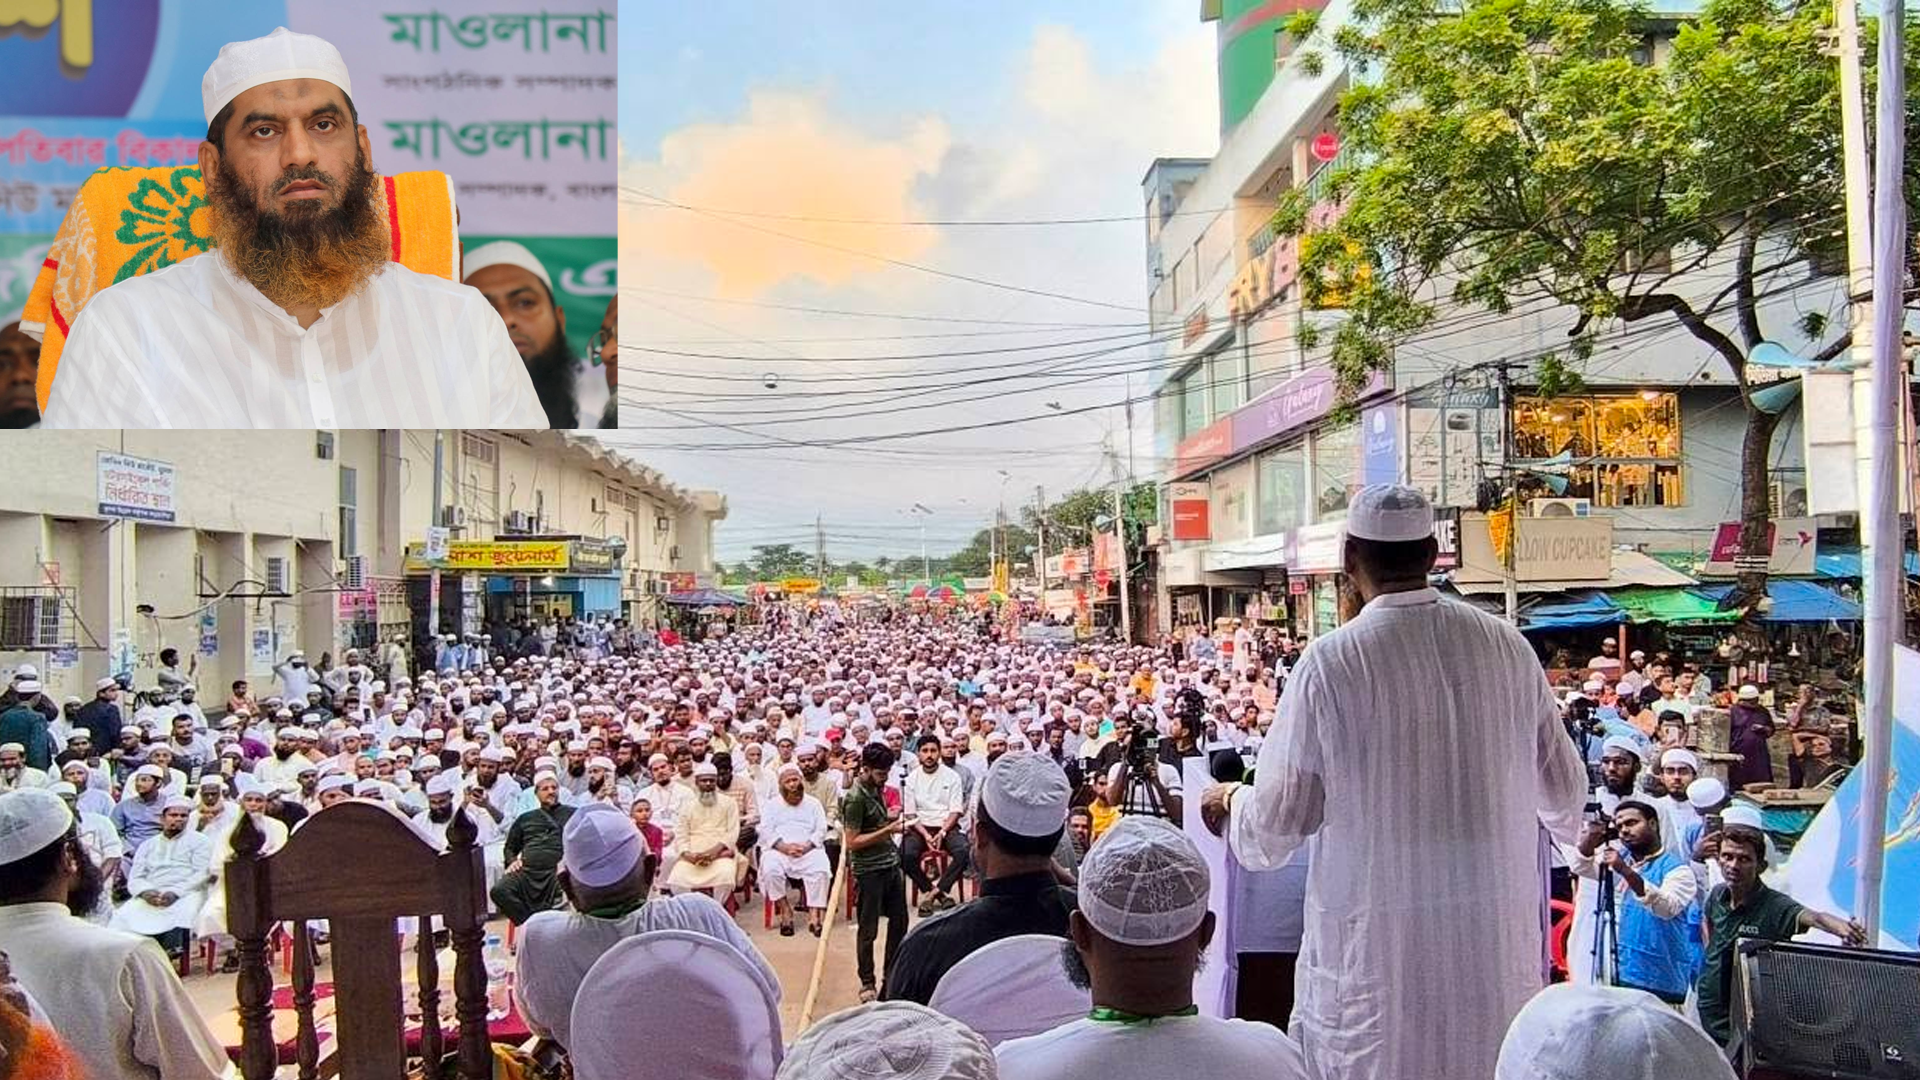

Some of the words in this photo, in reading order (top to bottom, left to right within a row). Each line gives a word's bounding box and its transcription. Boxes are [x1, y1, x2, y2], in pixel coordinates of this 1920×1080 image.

[382, 9, 616, 53] মাওলানা
[382, 115, 614, 160] মাওলানা
[1431, 519, 1456, 553] AKE
[1517, 538, 1549, 562] LLOW
[1552, 536, 1606, 562] CUPCAKE
